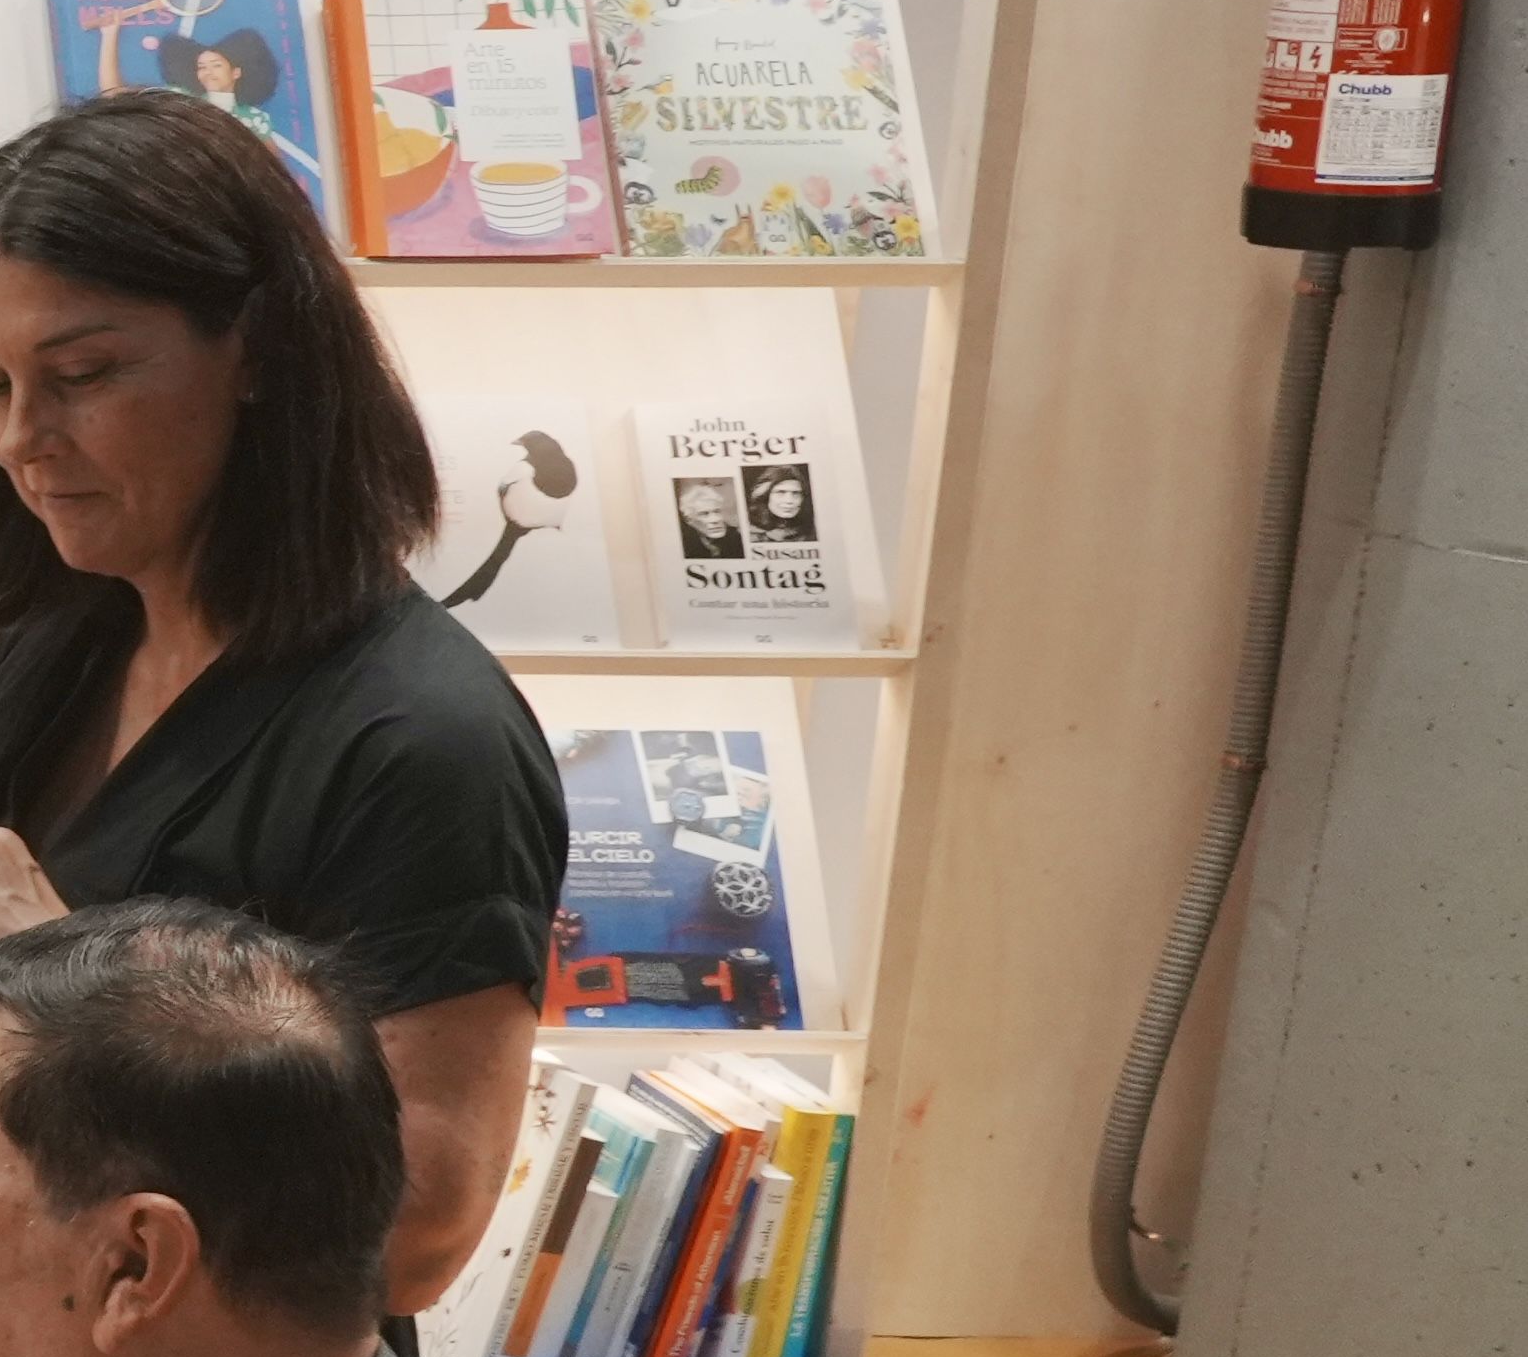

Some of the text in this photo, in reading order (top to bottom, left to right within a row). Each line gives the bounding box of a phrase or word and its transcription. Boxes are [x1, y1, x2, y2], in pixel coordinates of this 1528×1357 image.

[693, 58, 814, 87] ACUARELA
[1338, 83, 1392, 96] Chubb
[655, 92, 869, 132] SILVESTRE
[689, 417, 745, 433] John
[668, 433, 807, 462] Berger
[751, 544, 820, 560] Susan
[685, 562, 827, 594] Sontag
